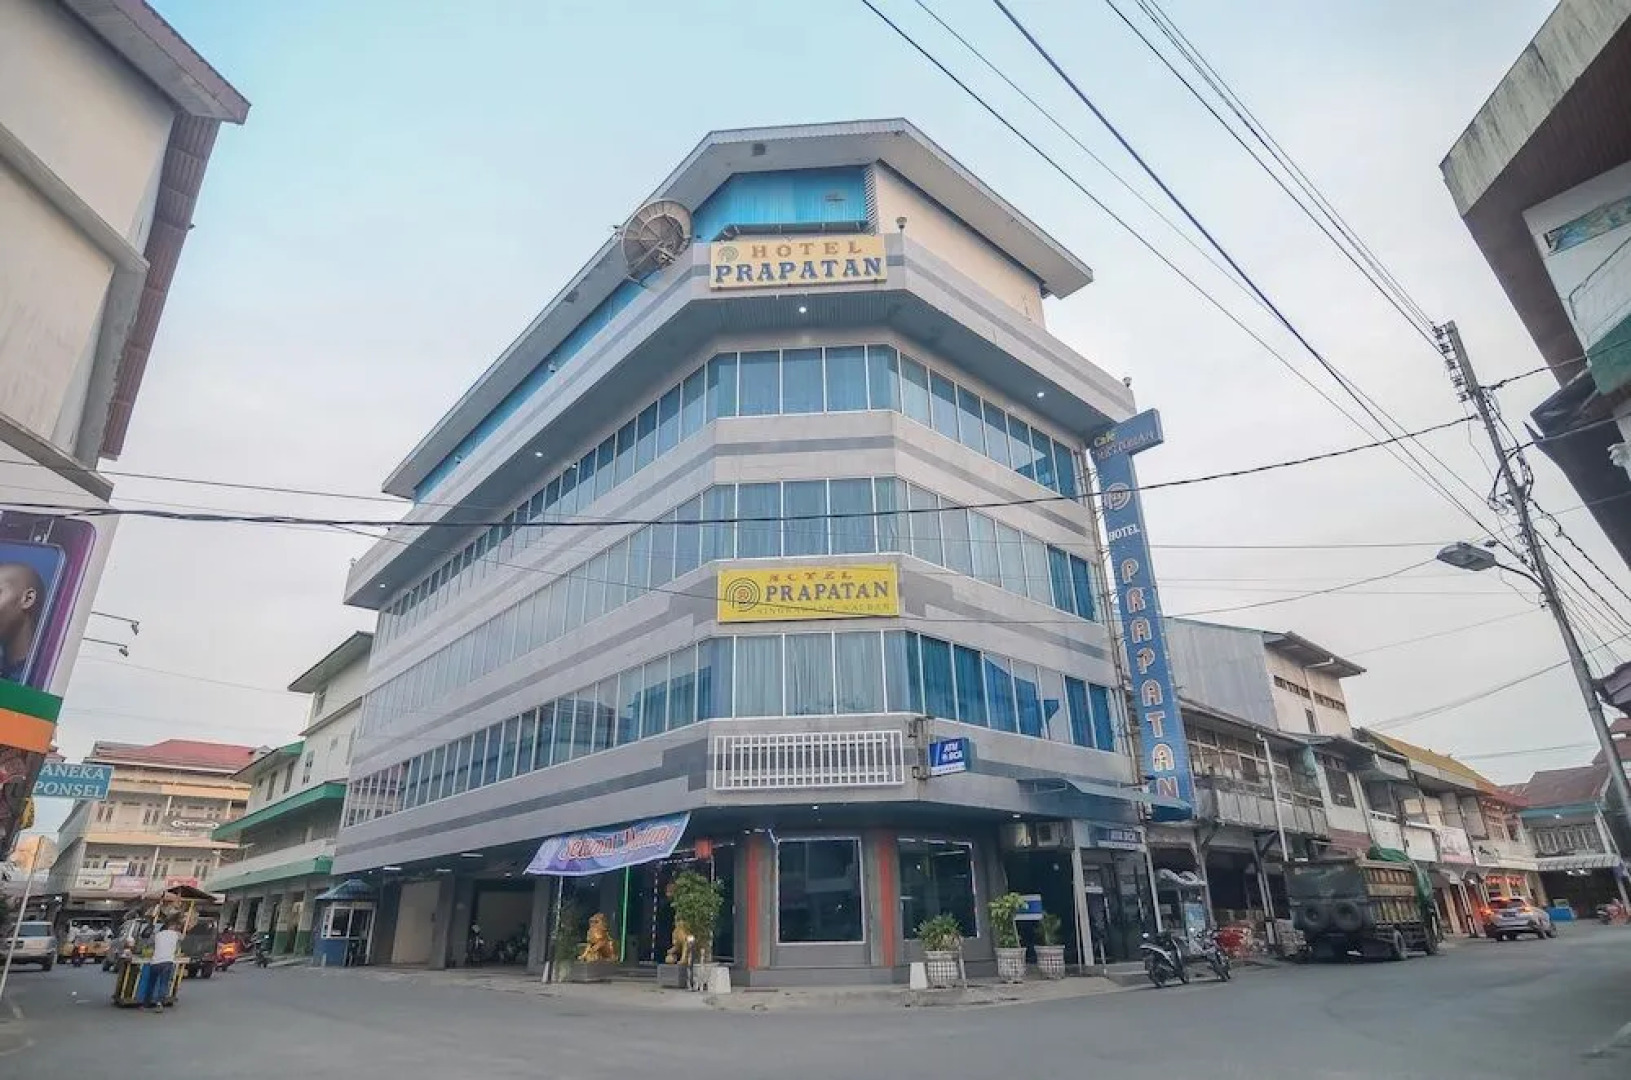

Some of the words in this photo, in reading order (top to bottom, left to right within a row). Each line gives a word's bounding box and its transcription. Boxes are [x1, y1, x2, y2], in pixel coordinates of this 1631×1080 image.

[752, 241, 862, 258] HOTEL
[715, 257, 882, 283] PRAPATAN
[1108, 524, 1141, 541] HOTEL
[766, 581, 888, 602] PRAPATAN
[1121, 557, 1180, 800] PRAPATAN
[944, 742, 958, 752] ATM
[39, 764, 105, 780] ANEKA
[33, 781, 104, 797] PONSEL
